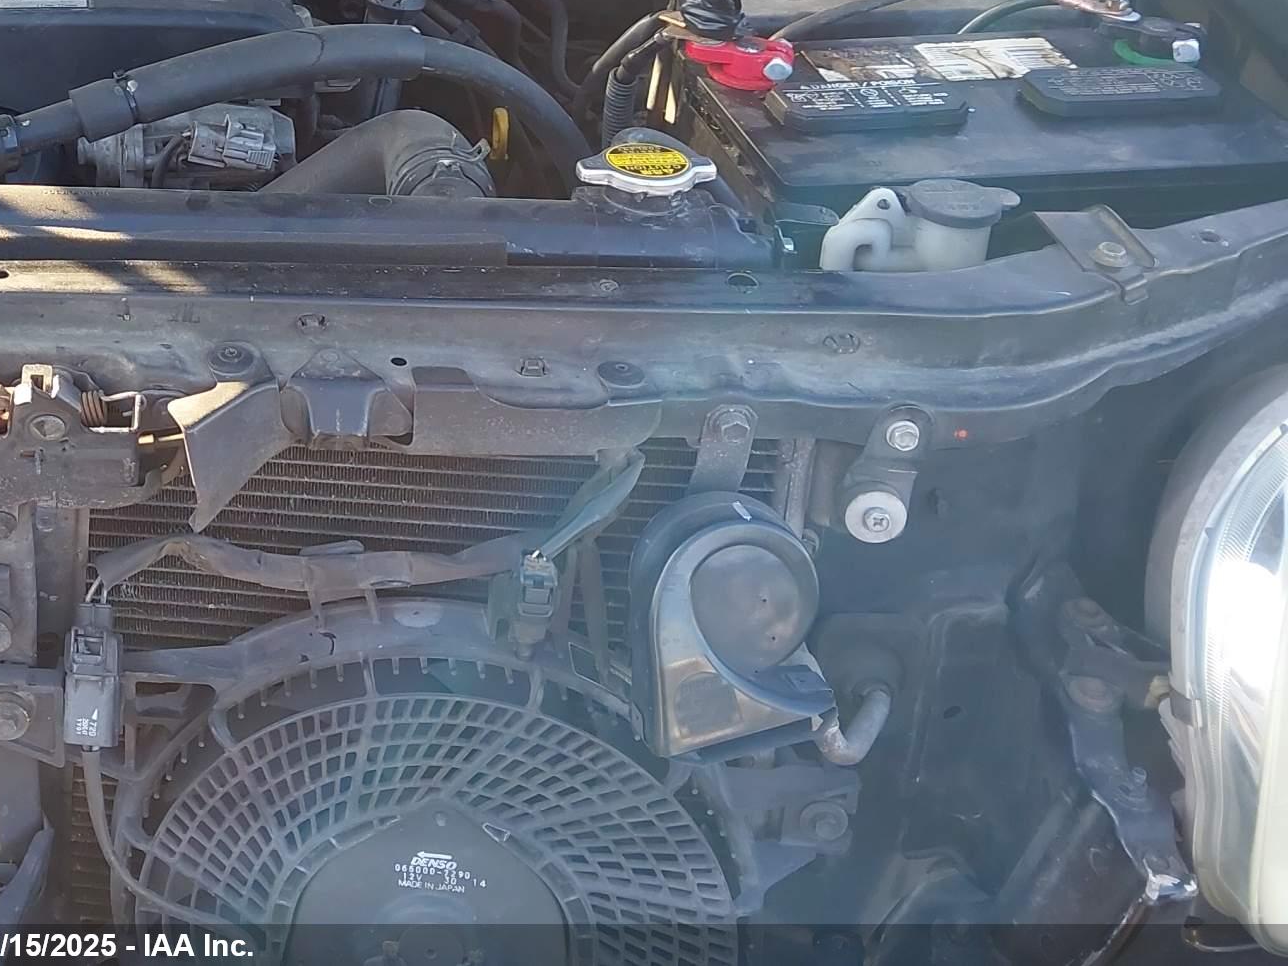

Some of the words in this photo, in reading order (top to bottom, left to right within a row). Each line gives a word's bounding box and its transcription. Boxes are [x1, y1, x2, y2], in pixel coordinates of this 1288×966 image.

[812, 81, 860, 90] DANGER
[870, 79, 916, 87] POISON
[411, 856, 457, 870] DENSO
[398, 879, 422, 889] MADE
[424, 882, 434, 891] IN
[435, 883, 465, 893] JAPAN
[473, 878, 487, 888] 14
